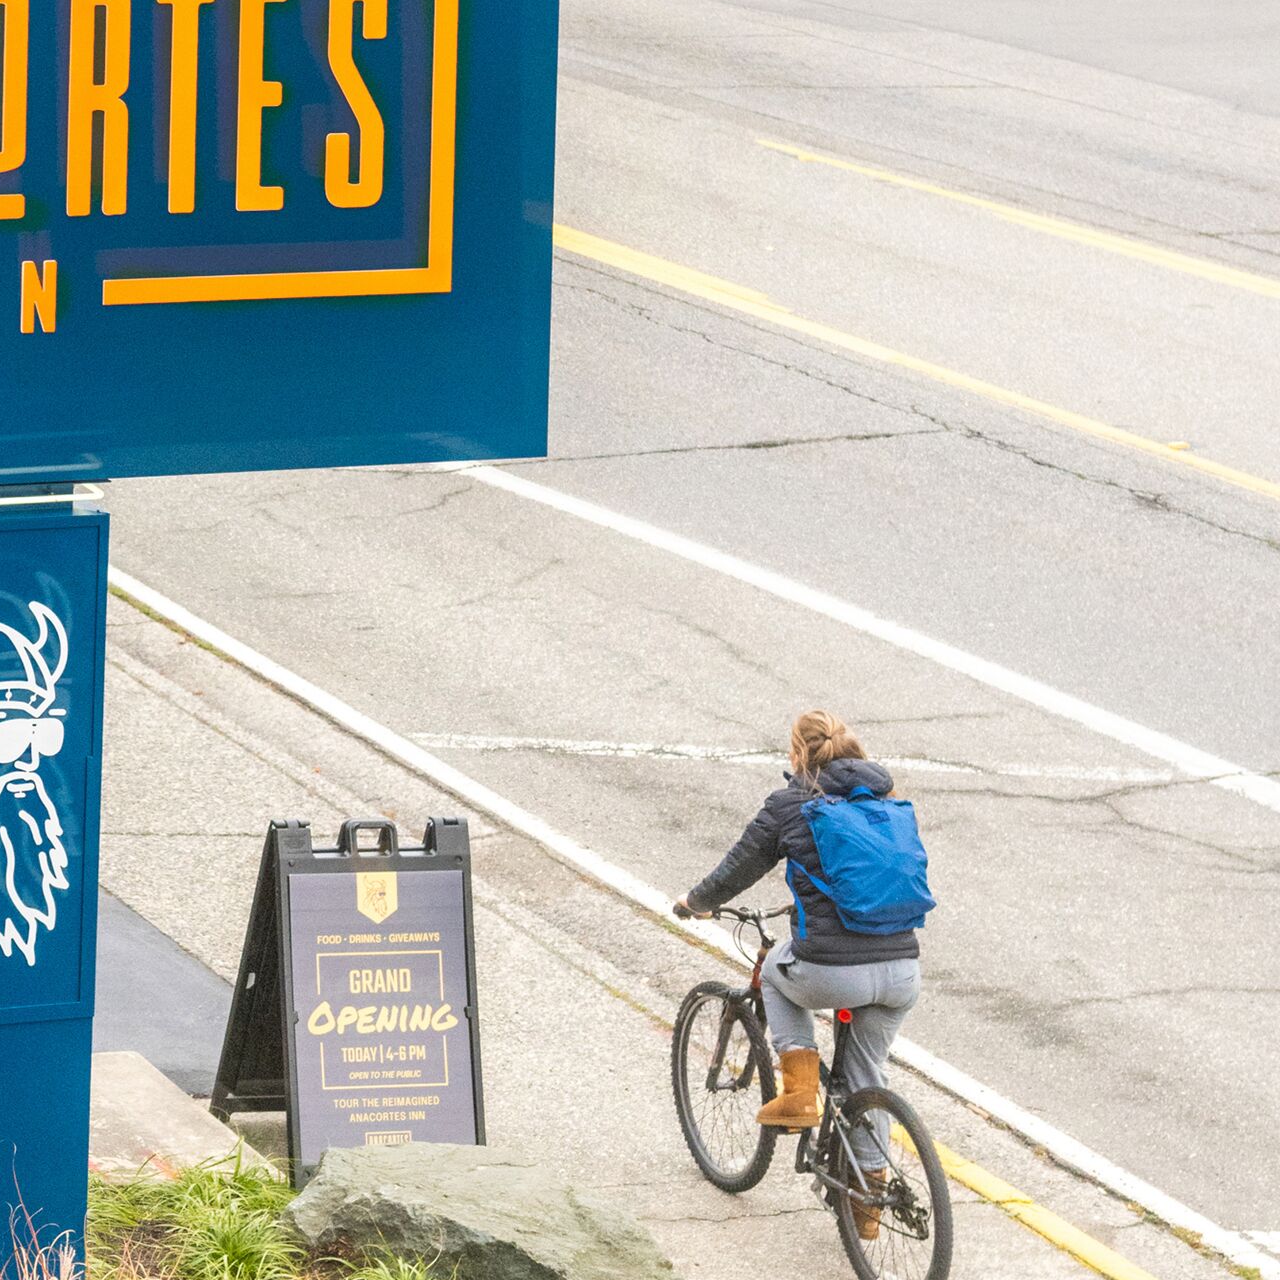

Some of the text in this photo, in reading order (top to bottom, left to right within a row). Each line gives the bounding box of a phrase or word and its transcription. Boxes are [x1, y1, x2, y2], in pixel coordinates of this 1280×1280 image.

[317, 932, 440, 945] FOOD DRINKS GIVEAWAYS
[349, 968, 412, 994] GRAND
[307, 1001, 459, 1035] OPENING
[341, 1045, 426, 1063] TODAY 4-6 PM
[349, 1070, 422, 1080] OPEN TO THE PUBLIC
[334, 1095, 440, 1109] TOUR THE REIMAGINED
[349, 1111, 426, 1123] ANACORTES INN
